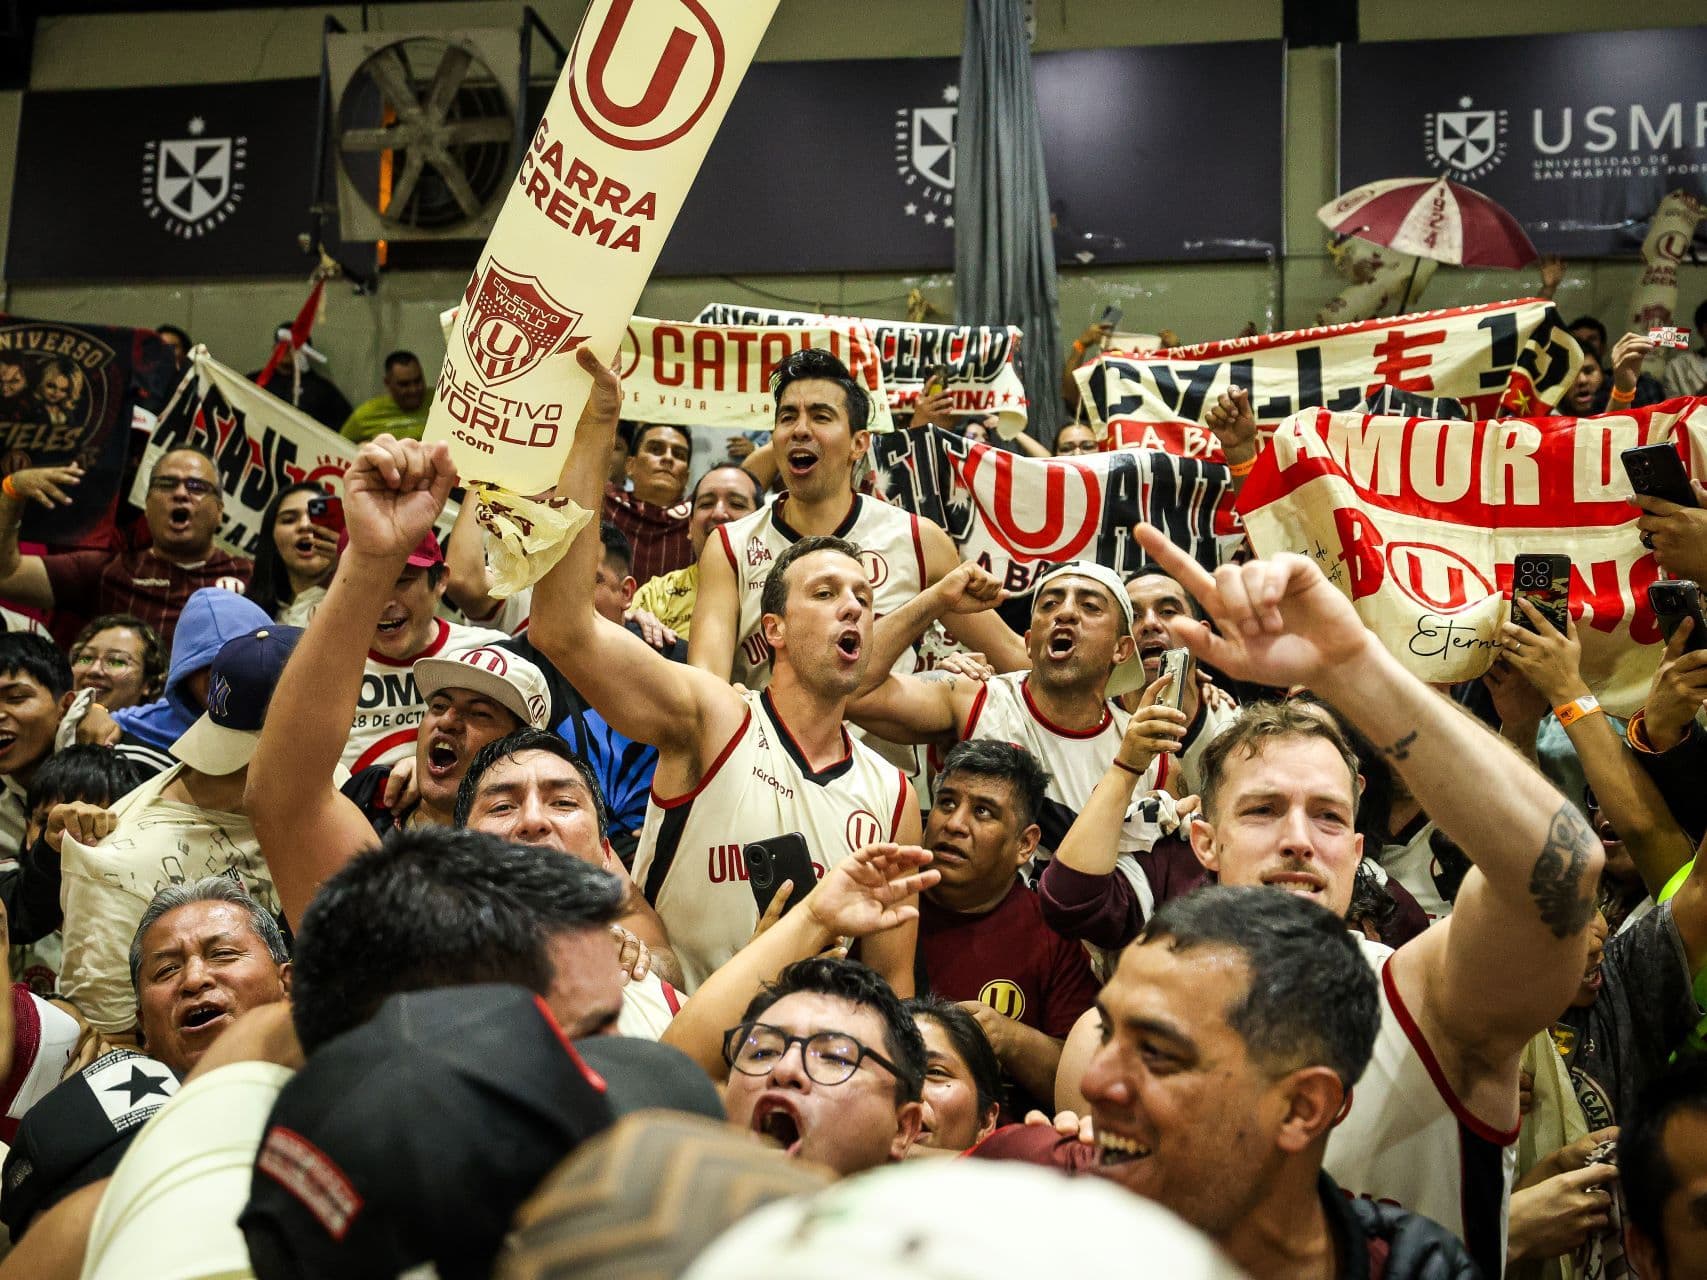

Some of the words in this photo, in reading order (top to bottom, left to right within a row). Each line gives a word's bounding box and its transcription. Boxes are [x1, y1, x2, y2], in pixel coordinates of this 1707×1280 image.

[533, 117, 657, 221] GARRA
[1534, 155, 1642, 169] UNIVERSIDAD
[1649, 153, 1669, 164] DE
[1534, 170, 1565, 180] SAN
[1572, 167, 1632, 178] MARTIN
[1640, 166, 1659, 176] DE
[519, 151, 641, 252] CREMA
[1423, 187, 1446, 249] 1924
[493, 276, 560, 324] COLECTIVO
[495, 291, 548, 330] WORLD
[652, 325, 879, 392] CATAN
[443, 352, 563, 422] OLECTIVO
[659, 396, 707, 410] VIDA
[437, 375, 558, 448] WORLD
[451, 429, 495, 454] .com
[1114, 422, 1166, 453] LA
[1274, 408, 1542, 505] AMOR
[372, 714, 391, 726] DE
